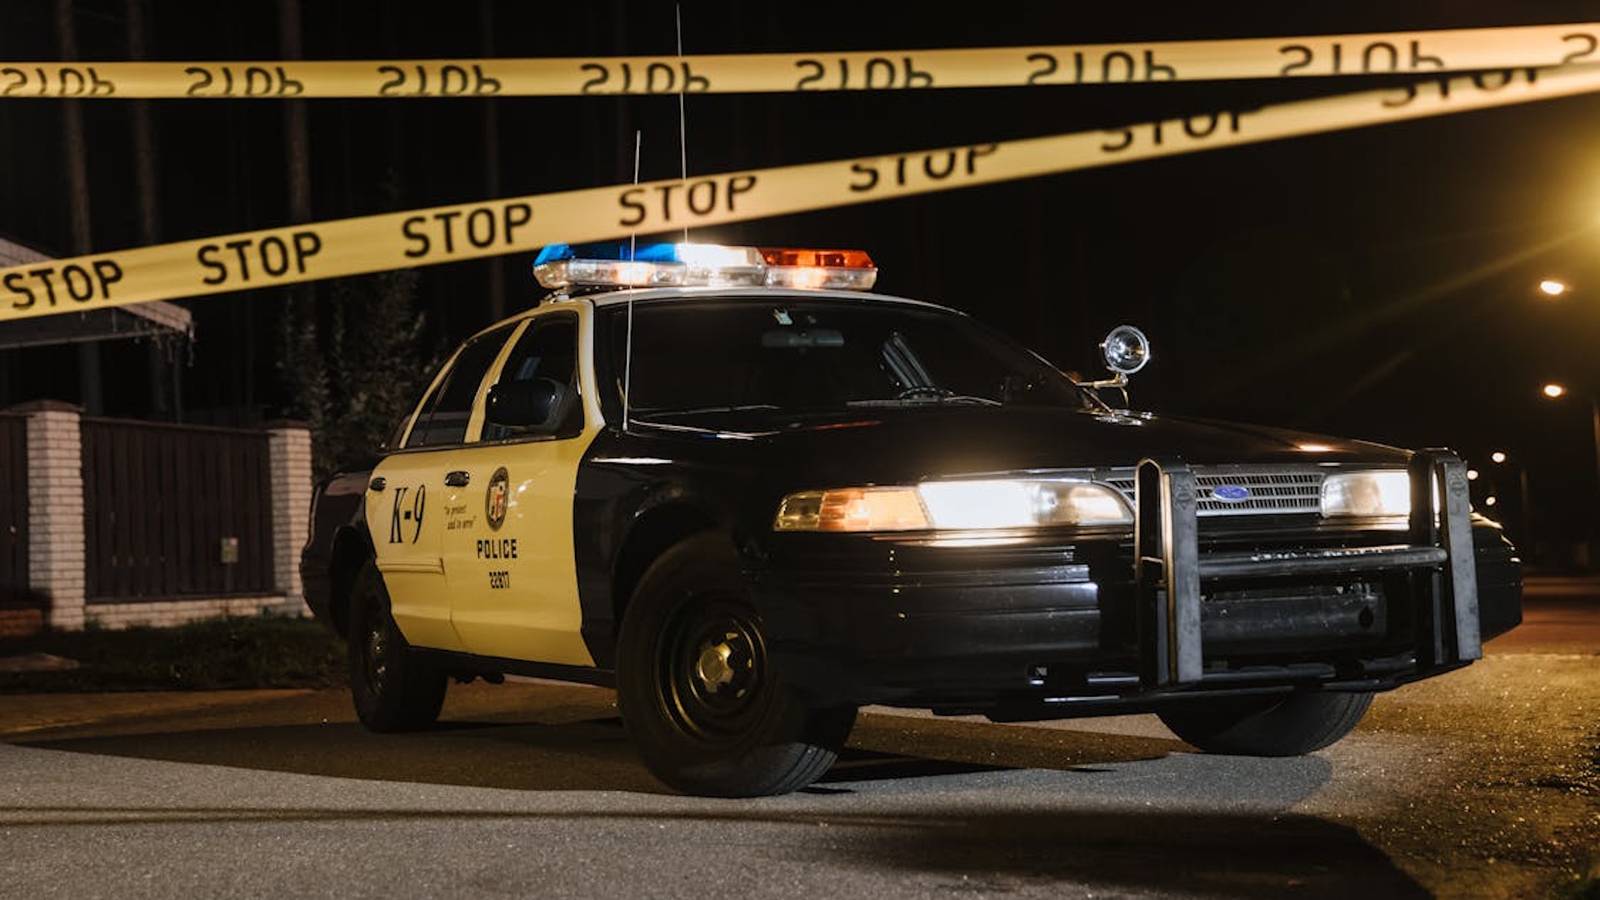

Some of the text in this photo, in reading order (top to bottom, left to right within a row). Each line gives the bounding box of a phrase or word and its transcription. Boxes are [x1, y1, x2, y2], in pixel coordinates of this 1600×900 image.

[2, 259, 124, 311] STOP
[196, 230, 322, 286] STOP
[402, 203, 533, 259] STOP
[618, 175, 757, 227] STOP
[389, 484, 426, 544] K-9
[477, 539, 518, 559] POLICE
